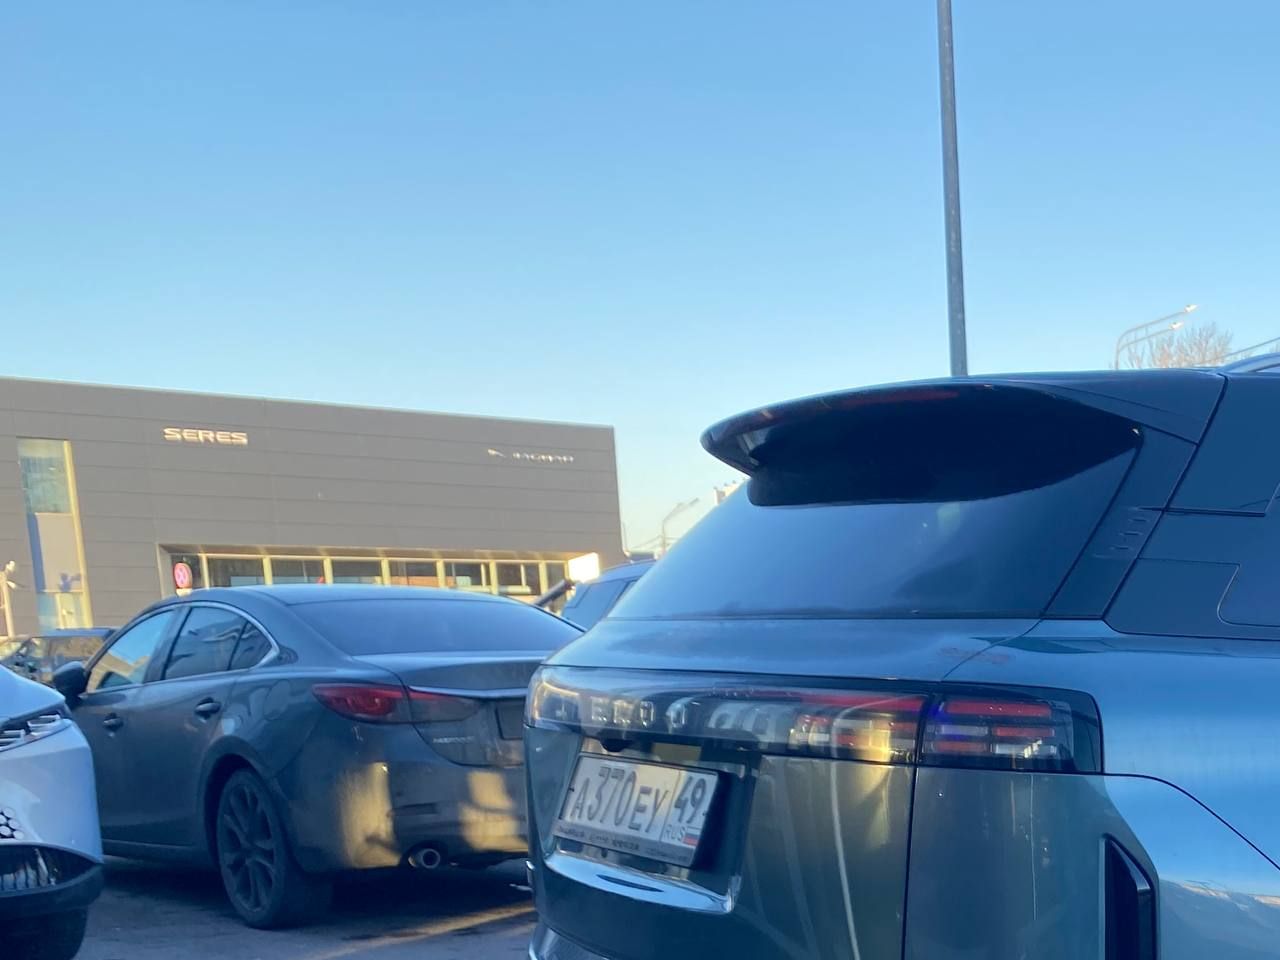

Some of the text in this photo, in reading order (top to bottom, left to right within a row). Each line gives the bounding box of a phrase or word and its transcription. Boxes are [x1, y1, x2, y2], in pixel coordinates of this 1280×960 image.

[163, 427, 248, 446] SERES
[674, 775, 706, 824] 49
[663, 824, 686, 841] RUS
